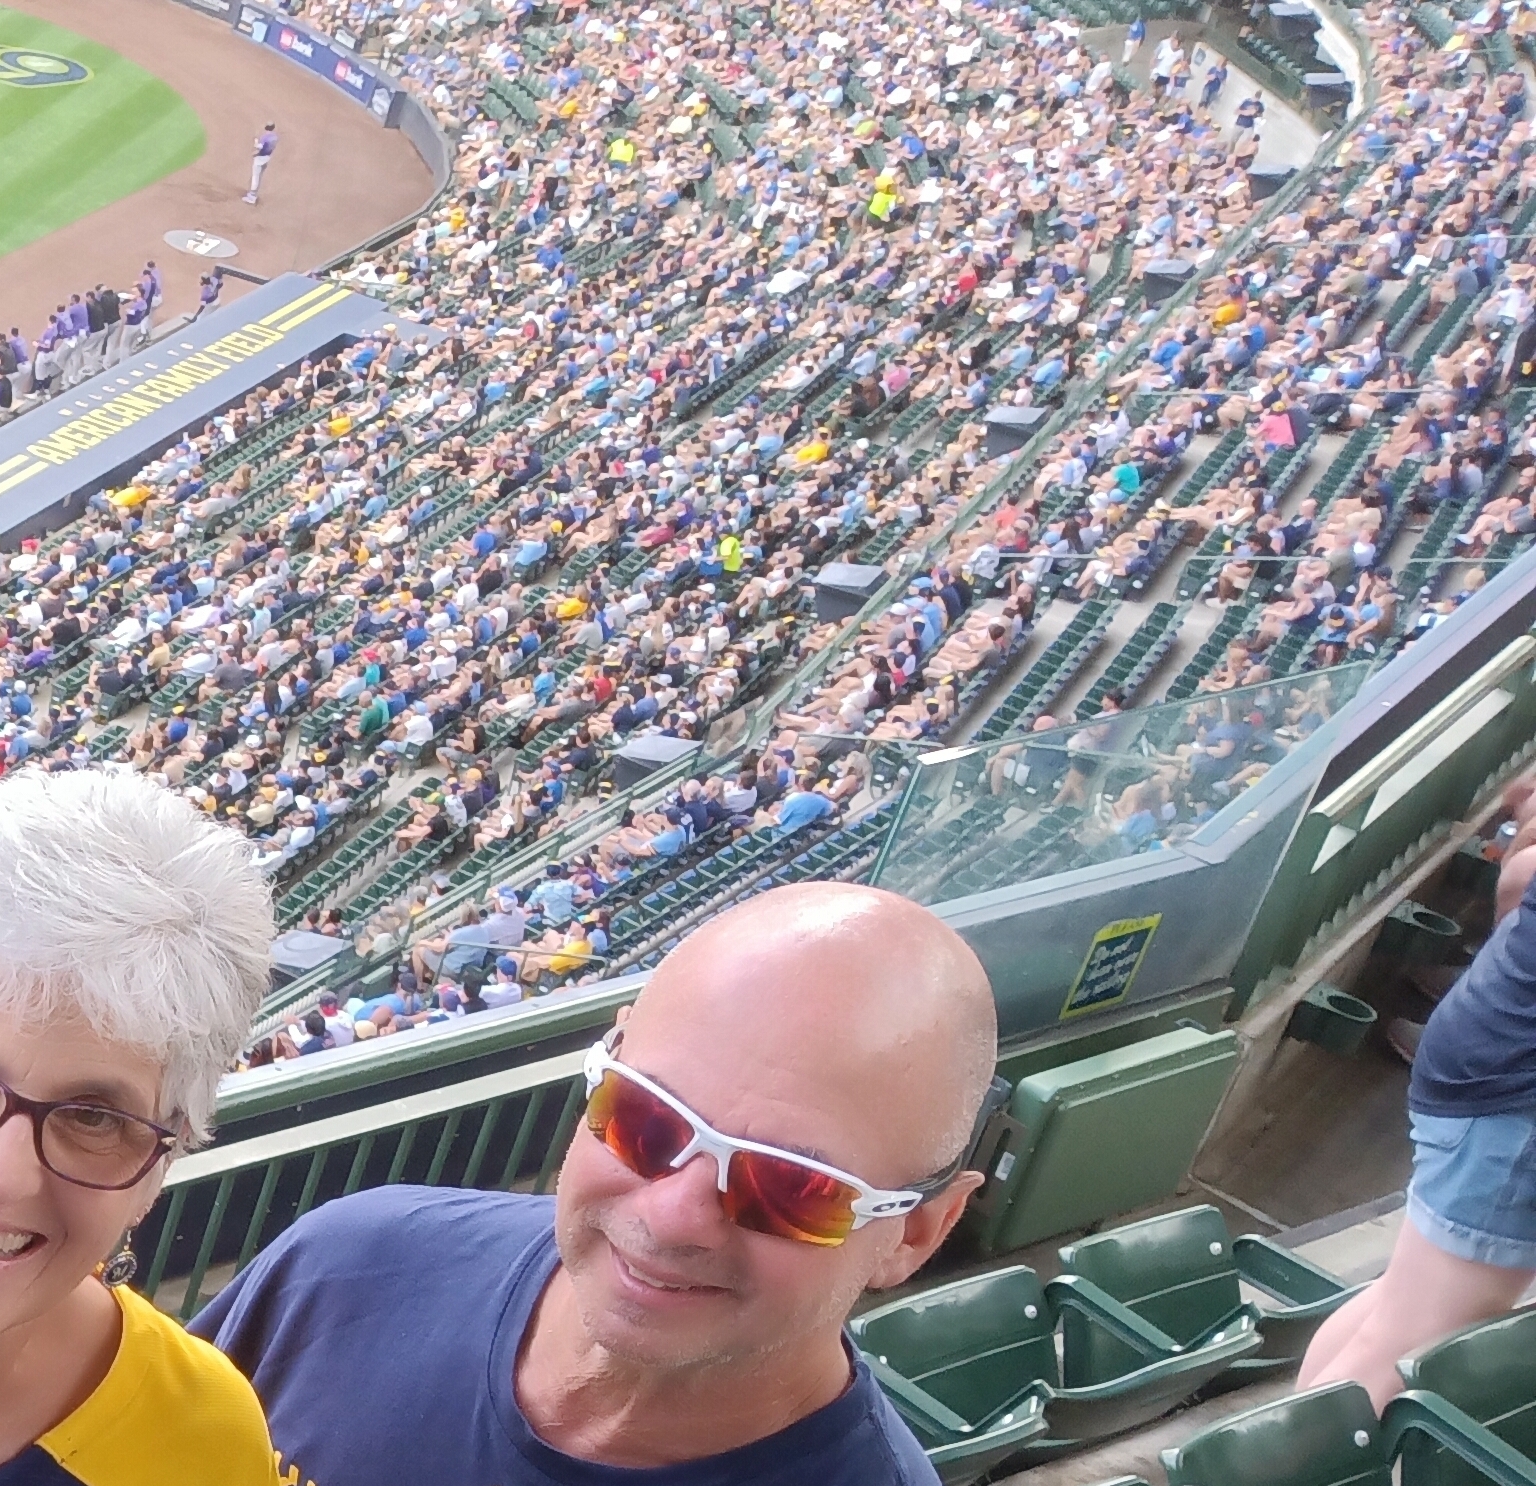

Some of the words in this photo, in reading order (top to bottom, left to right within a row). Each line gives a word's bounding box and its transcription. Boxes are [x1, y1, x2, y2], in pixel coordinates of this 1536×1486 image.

[26, 392, 163, 465] AMERICAN
[131, 352, 232, 403] FAMILY
[203, 322, 284, 363] FIELD
